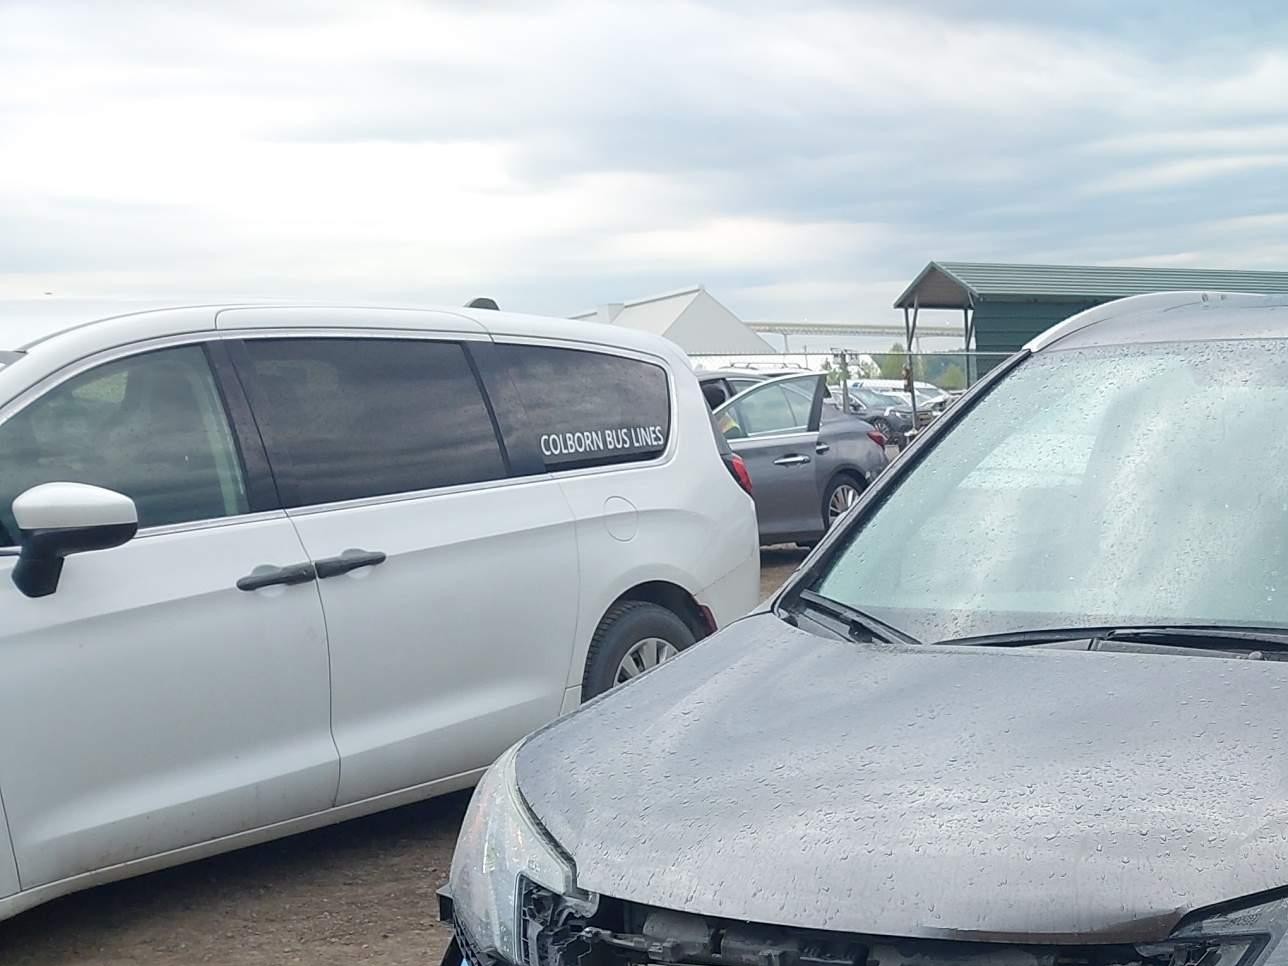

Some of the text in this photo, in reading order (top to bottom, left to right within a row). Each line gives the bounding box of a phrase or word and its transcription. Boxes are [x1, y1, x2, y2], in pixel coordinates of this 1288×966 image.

[541, 426, 664, 455] COLBORN BUS LINES
